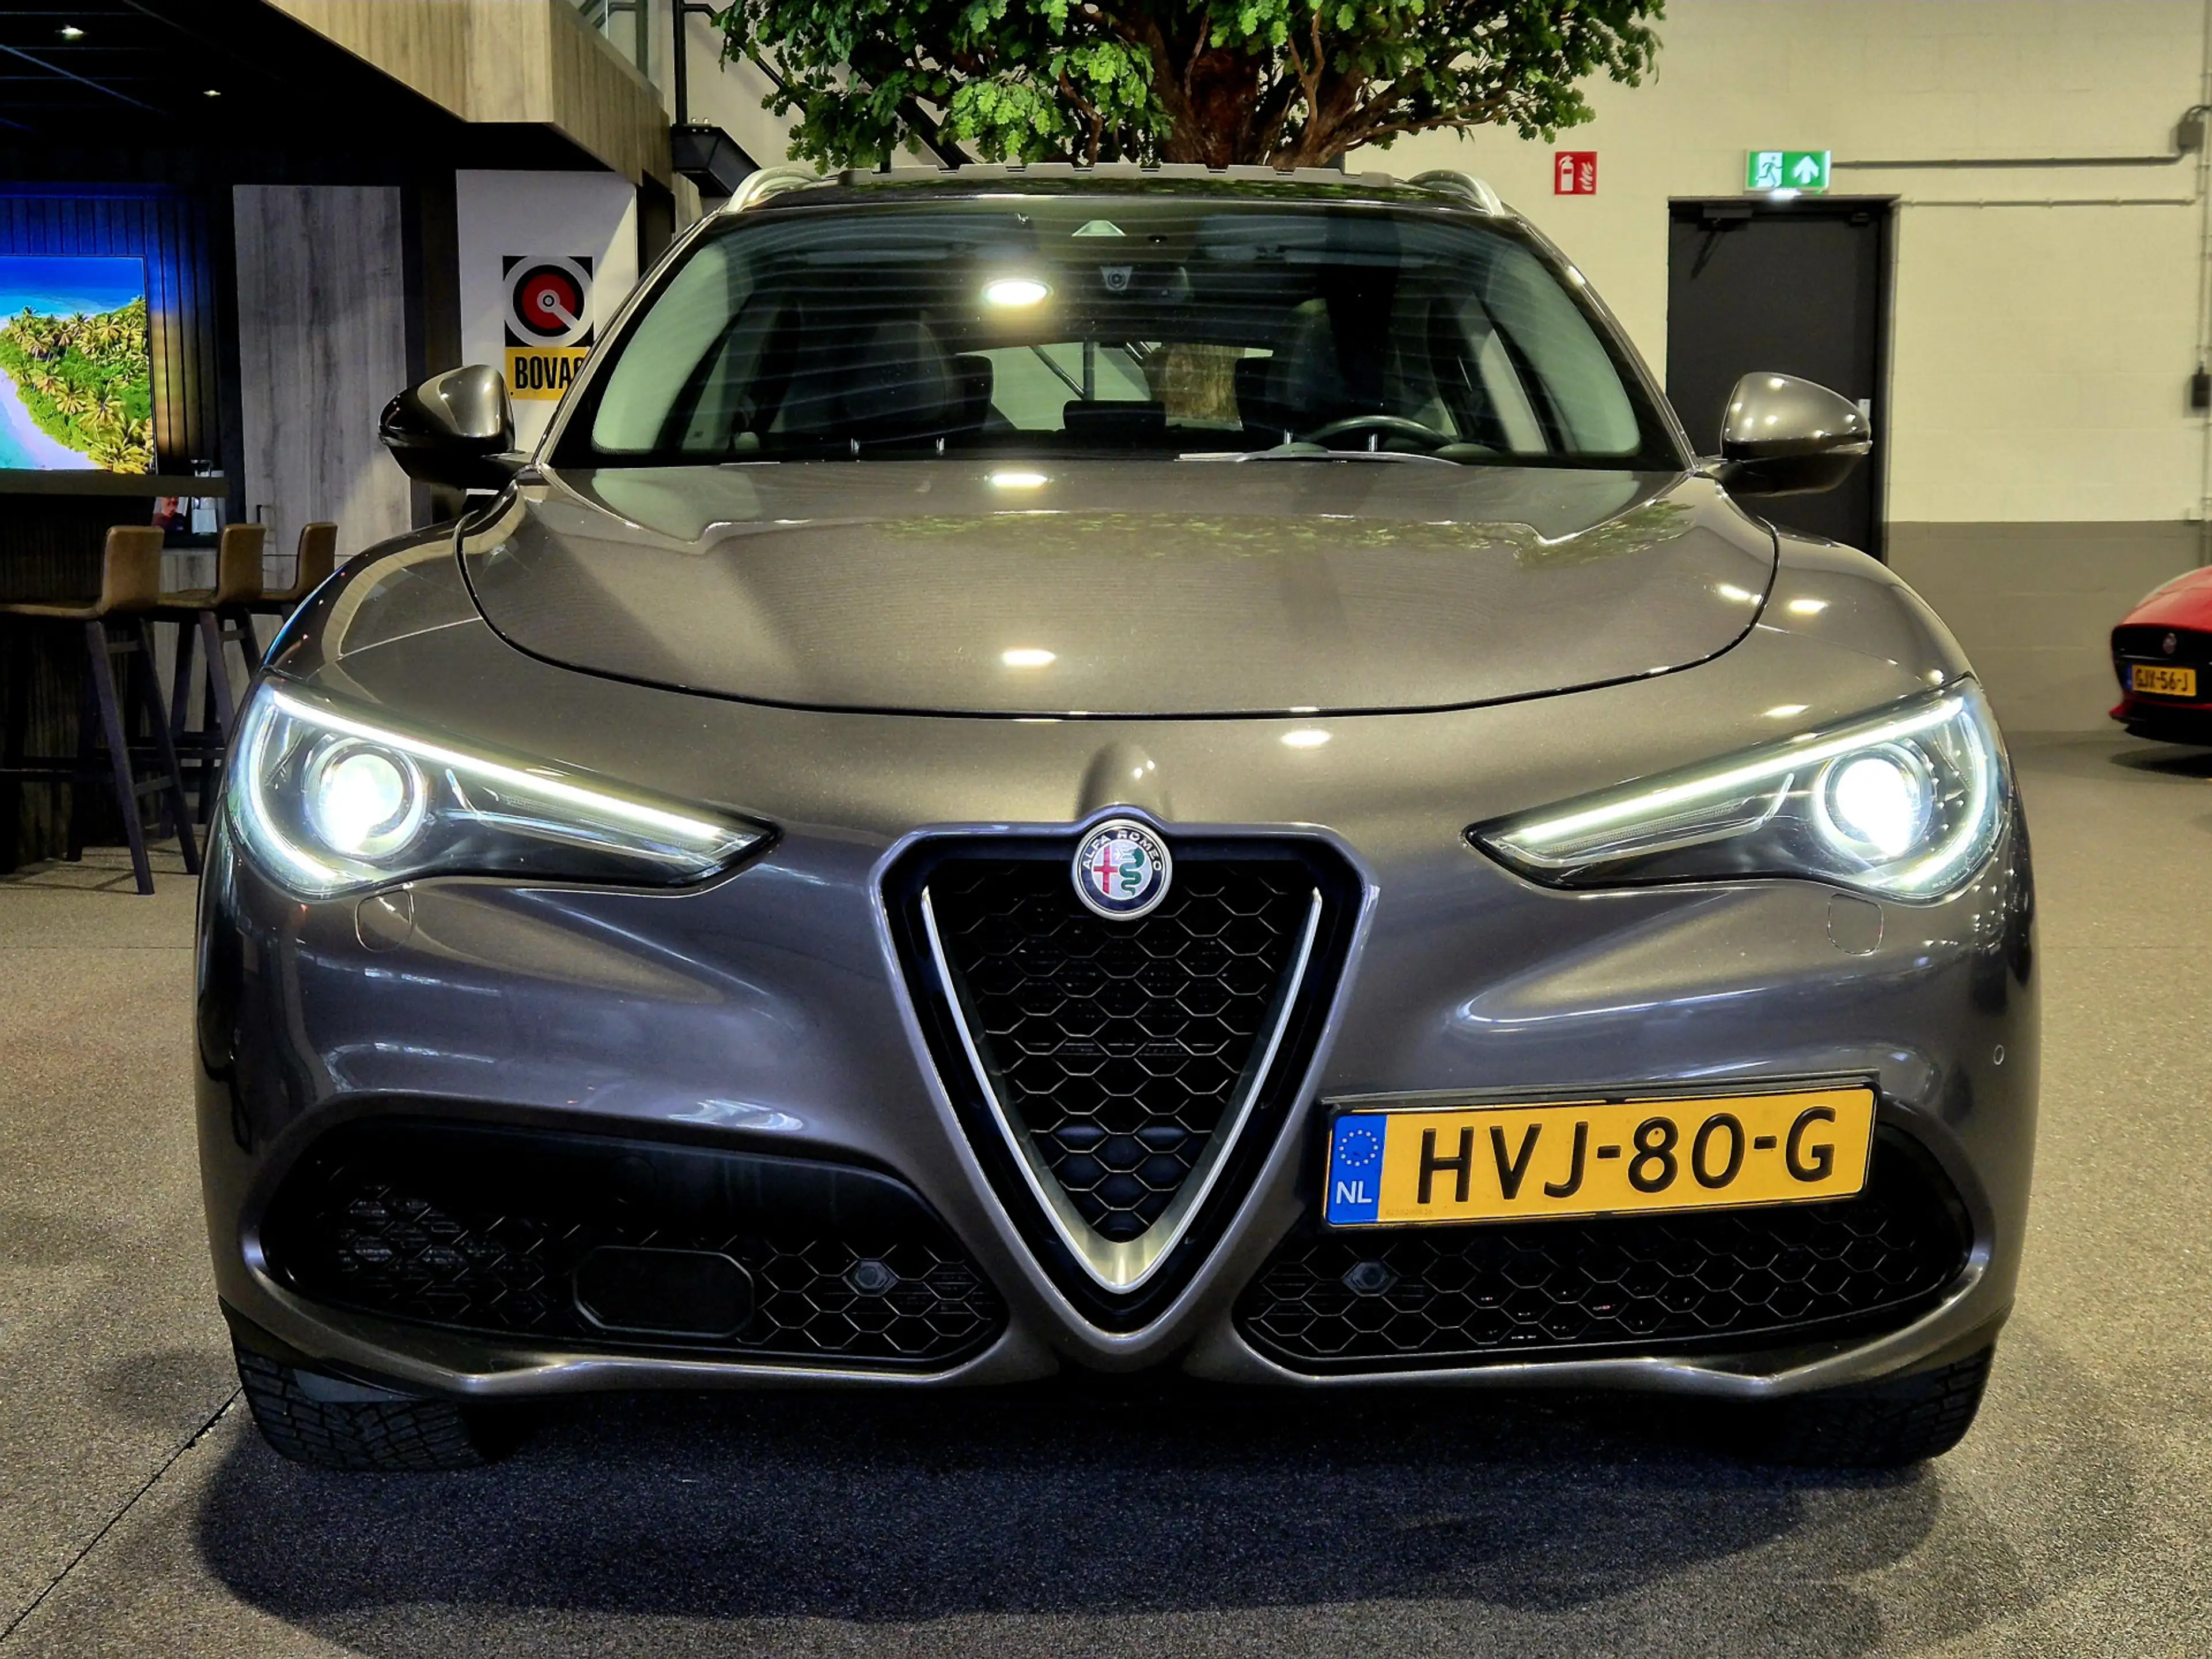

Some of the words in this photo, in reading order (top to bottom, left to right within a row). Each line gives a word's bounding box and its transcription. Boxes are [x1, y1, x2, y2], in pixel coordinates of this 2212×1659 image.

[1083, 835, 1111, 870] ALFA
[1117, 830, 1162, 872] ROMEO
[1417, 1105, 1836, 1204] HVJ-80-G
[1336, 1180, 1373, 1205] NL
